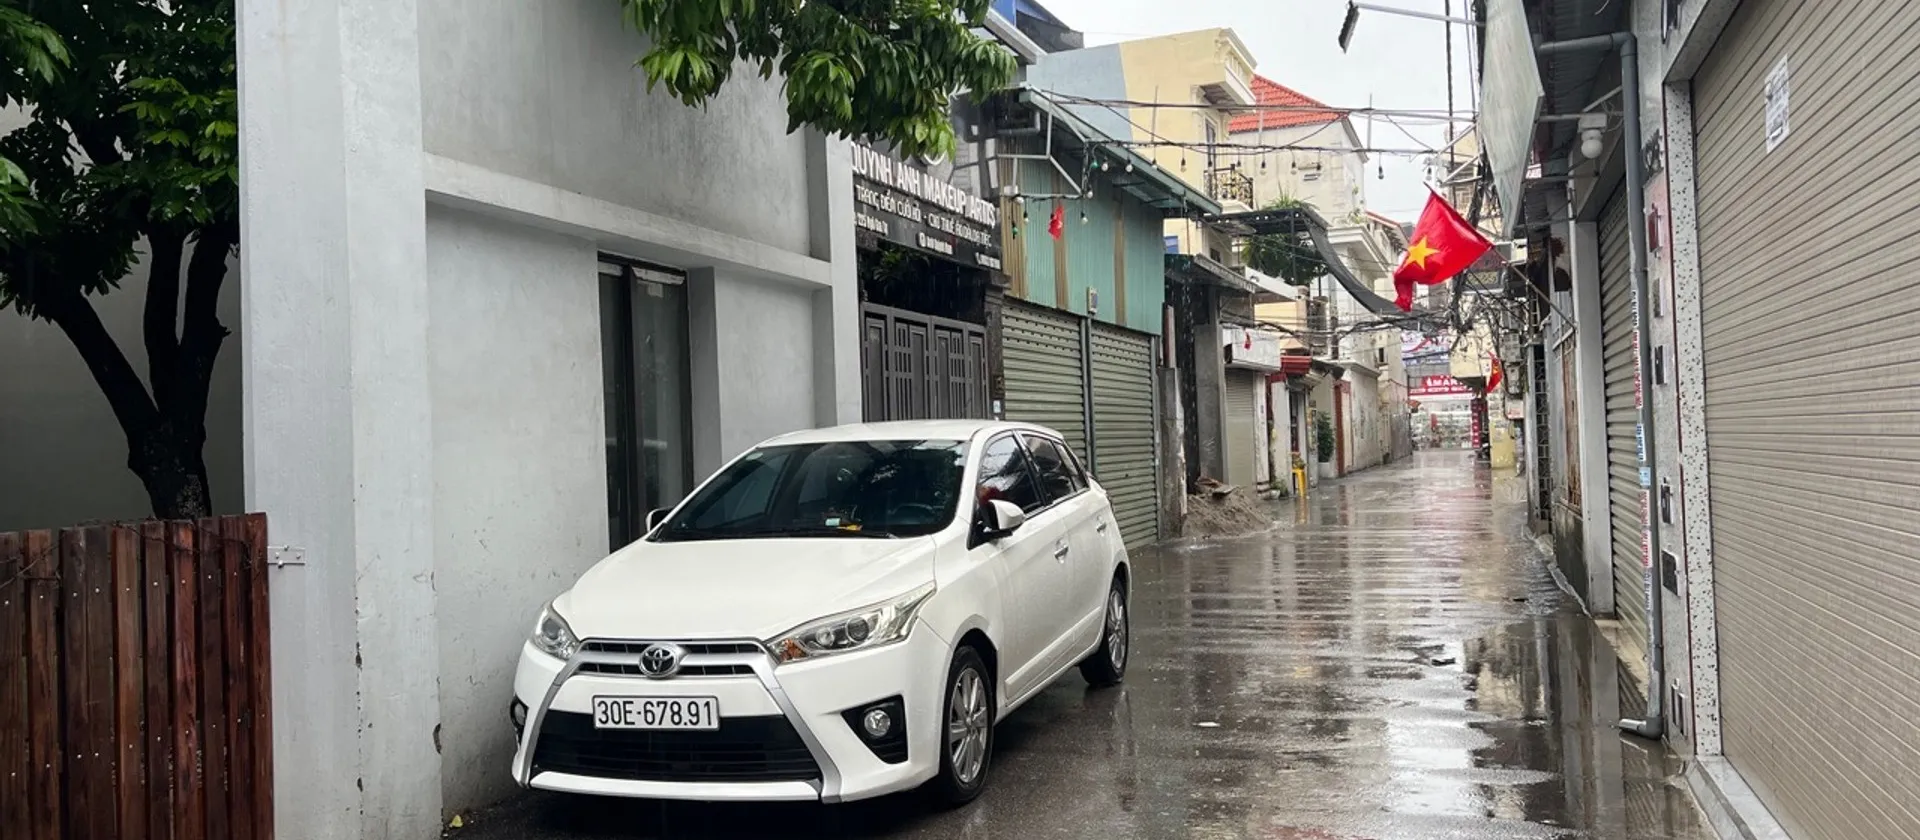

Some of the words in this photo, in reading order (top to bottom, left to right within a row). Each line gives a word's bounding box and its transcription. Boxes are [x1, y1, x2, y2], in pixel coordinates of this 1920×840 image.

[897, 162, 920, 196] ANH
[923, 173, 966, 213] MAKEUP
[597, 700, 712, 726] 30E-678.91
